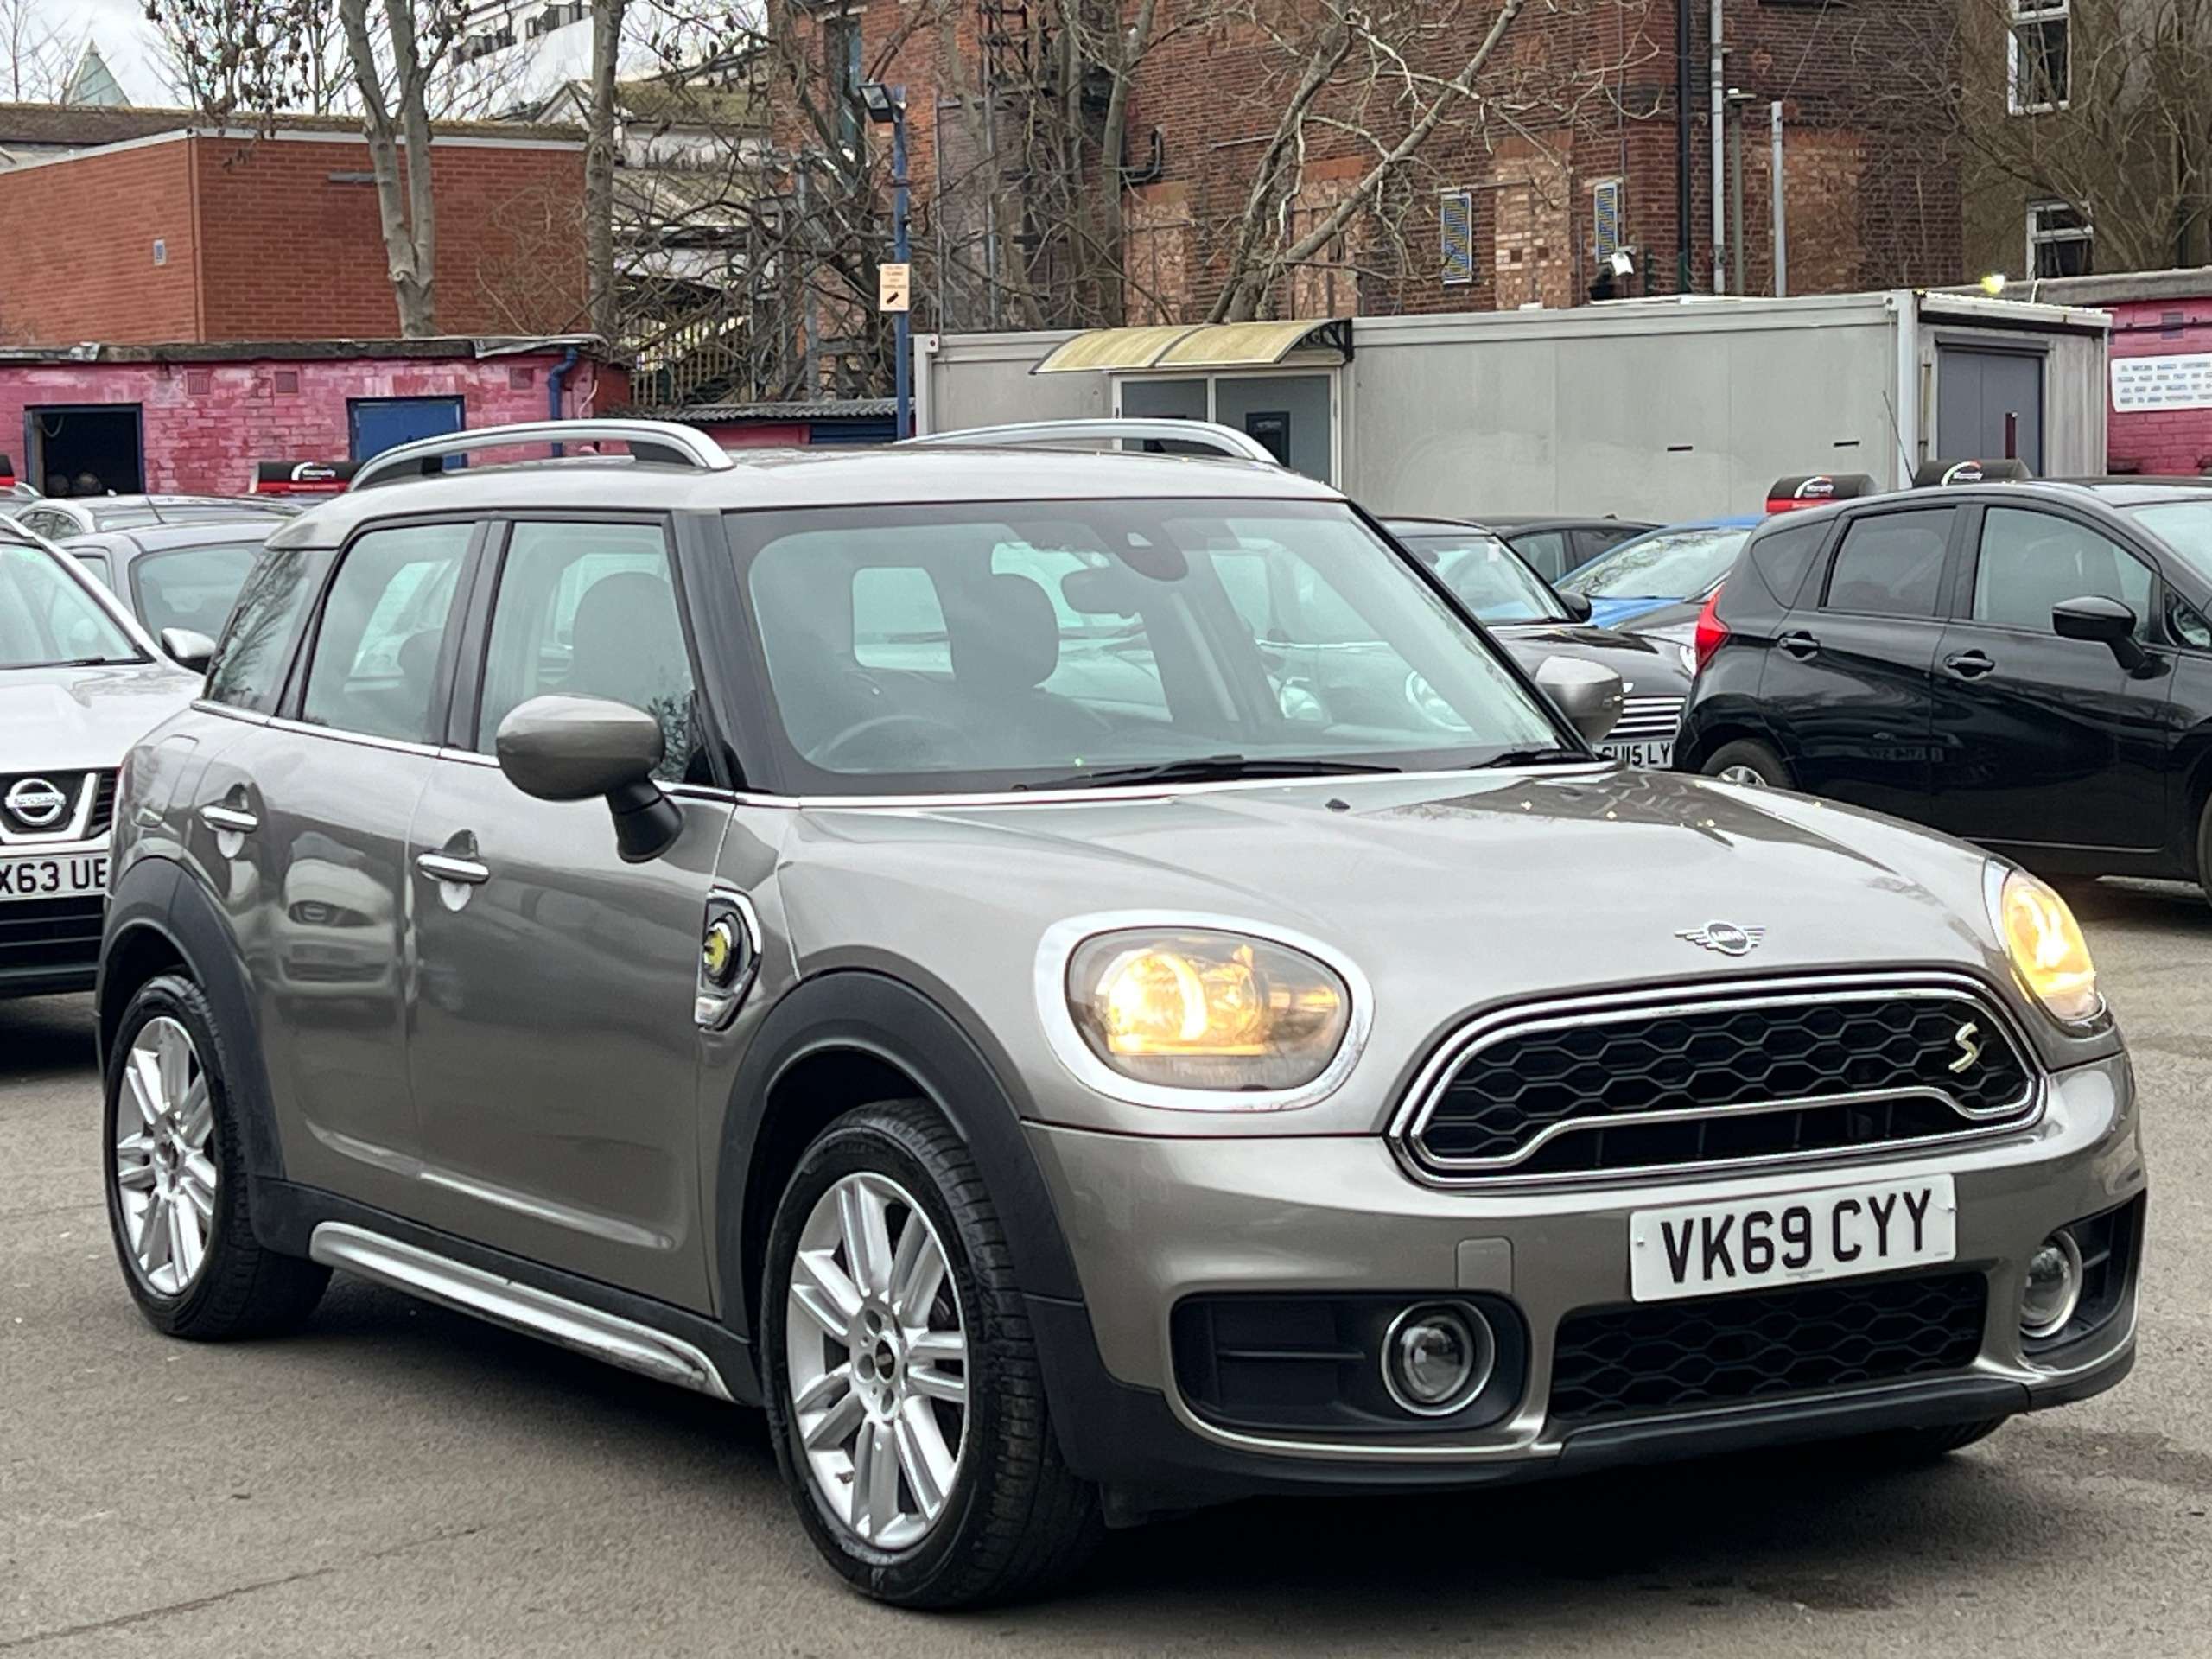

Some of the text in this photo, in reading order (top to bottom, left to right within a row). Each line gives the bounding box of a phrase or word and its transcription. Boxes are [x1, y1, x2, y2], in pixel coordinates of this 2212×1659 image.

[1647, 743, 1670, 765] LY
[71, 858, 108, 889] UE
[1948, 1022, 1978, 1073] S
[1660, 1188, 1932, 1284] VK69 CYY
